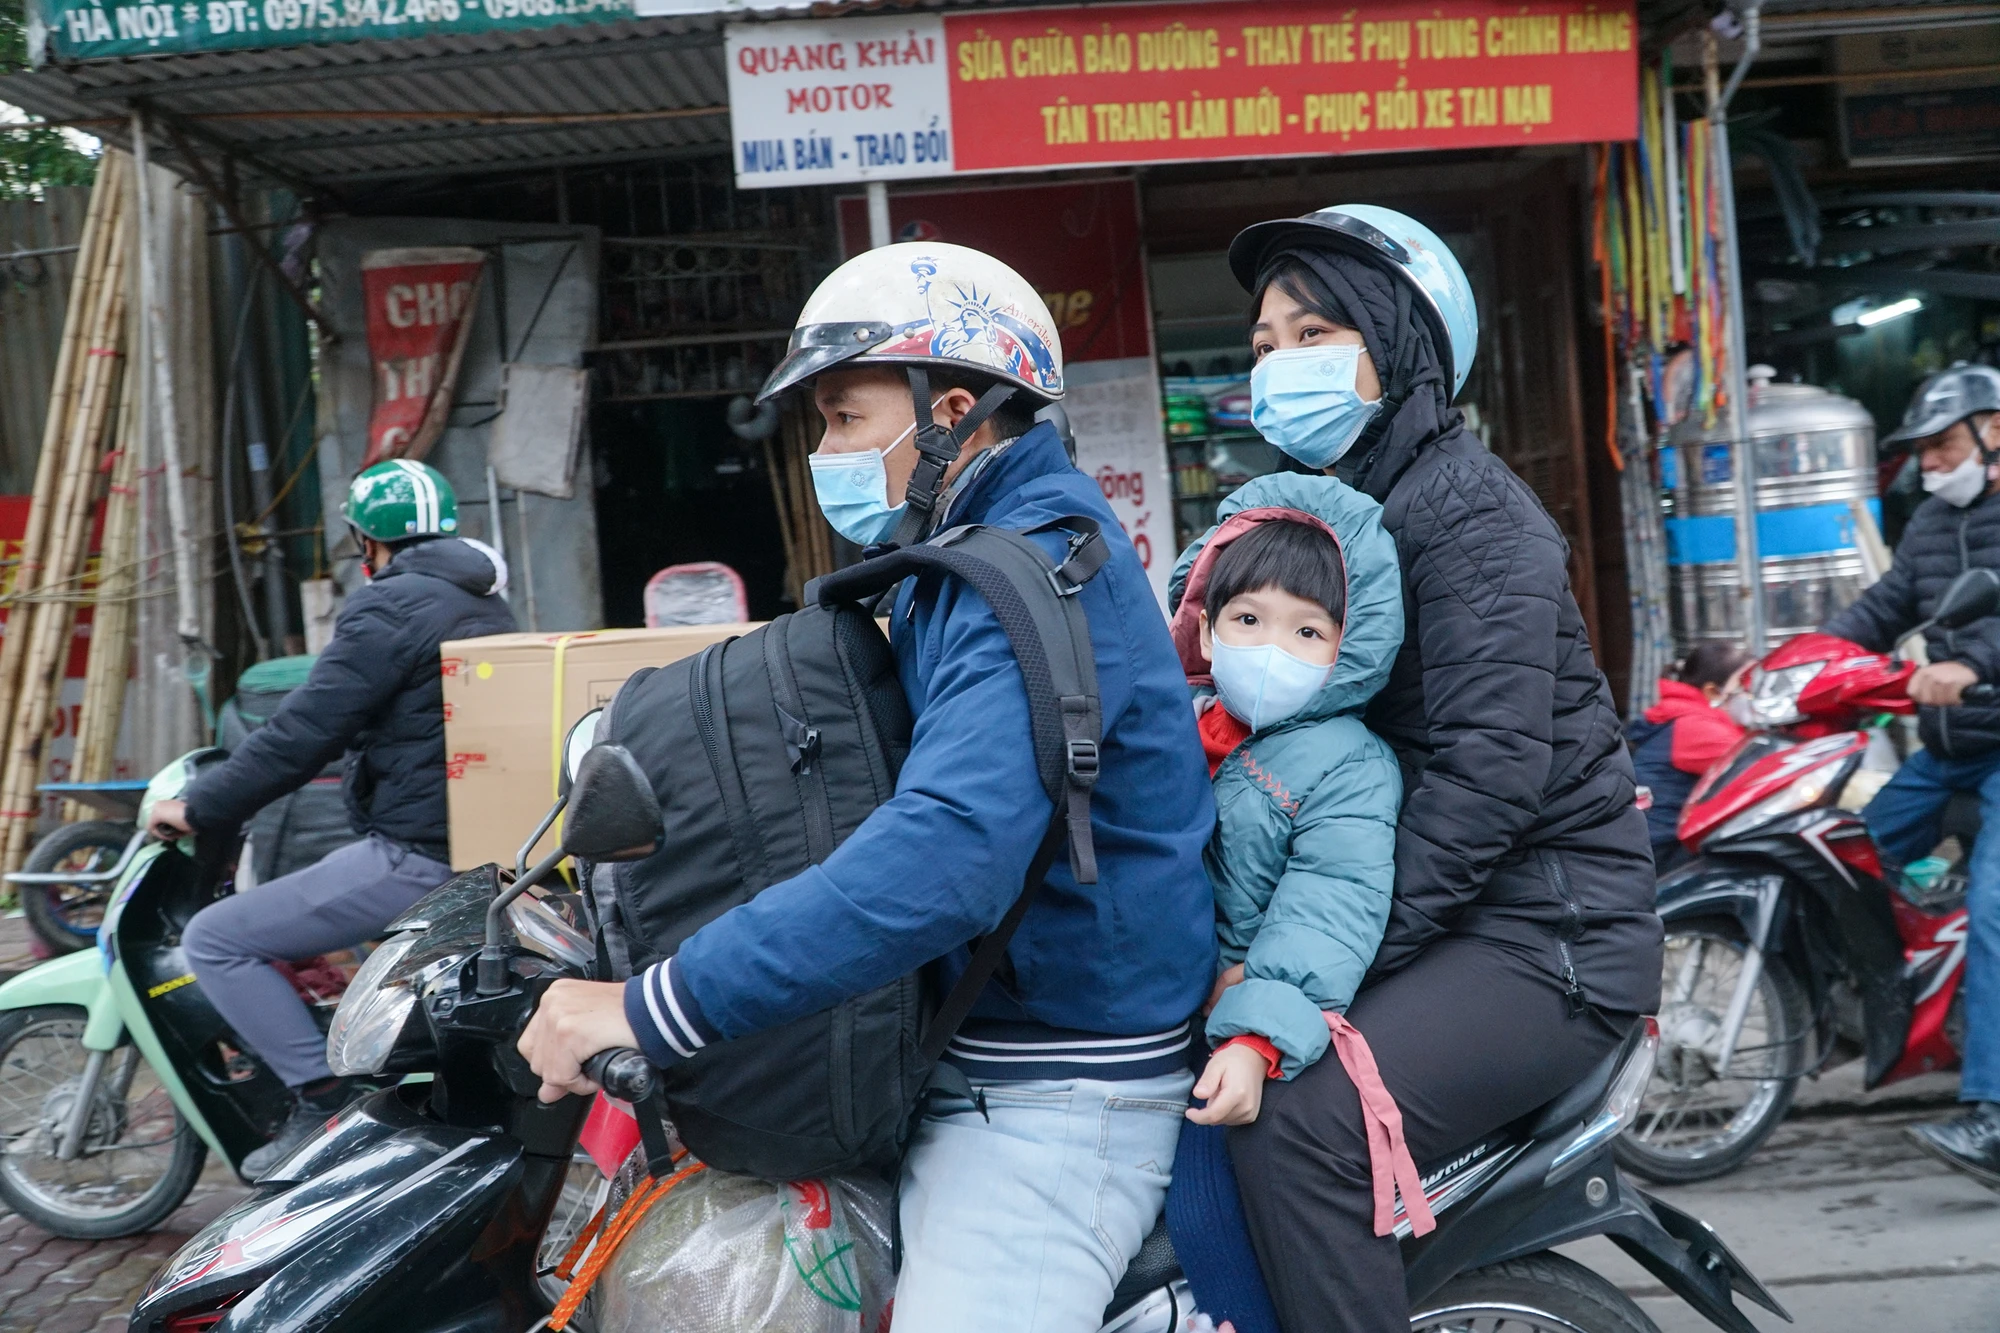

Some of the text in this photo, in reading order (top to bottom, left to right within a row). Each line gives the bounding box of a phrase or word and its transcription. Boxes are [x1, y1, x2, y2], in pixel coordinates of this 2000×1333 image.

[65, 0, 115, 43] HÀ
[207, 1, 258, 34] ĐT:
[264, 0, 459, 31] 0975.842.466
[958, 29, 1007, 81] SỬA
[1011, 28, 1079, 77] CHỮA
[1083, 23, 1131, 73] BẢO
[1138, 22, 1219, 71] DƯỠNG
[1242, 25, 1304, 67] THAY
[1309, 8, 1355, 63] THẾ
[1362, 21, 1411, 69] PHỤ
[1417, 9, 1478, 59] TÙNG
[1486, 5, 1560, 57] CHÍNH
[738, 29, 934, 75] QUANG KHẢI
[786, 84, 893, 113] MOTOR
[1041, 96, 1088, 144] TÂN
[1093, 101, 1171, 142] TRANG
[1177, 90, 1228, 139] LÀM
[1234, 86, 1281, 137] MỚI
[1305, 91, 1369, 141] PHỤC
[1423, 89, 1454, 128] XE
[1459, 87, 1497, 126] TAI
[1504, 84, 1552, 133] NẠN
[742, 140, 787, 173] MUA
[793, 129, 833, 170] BÁN
[854, 133, 906, 167] TRAO
[914, 115, 947, 163] ĐỔI
[1002, 302, 1053, 350] Amerika
[1096, 465, 1144, 507] ỡng
[1420, 1144, 1487, 1190] wave
